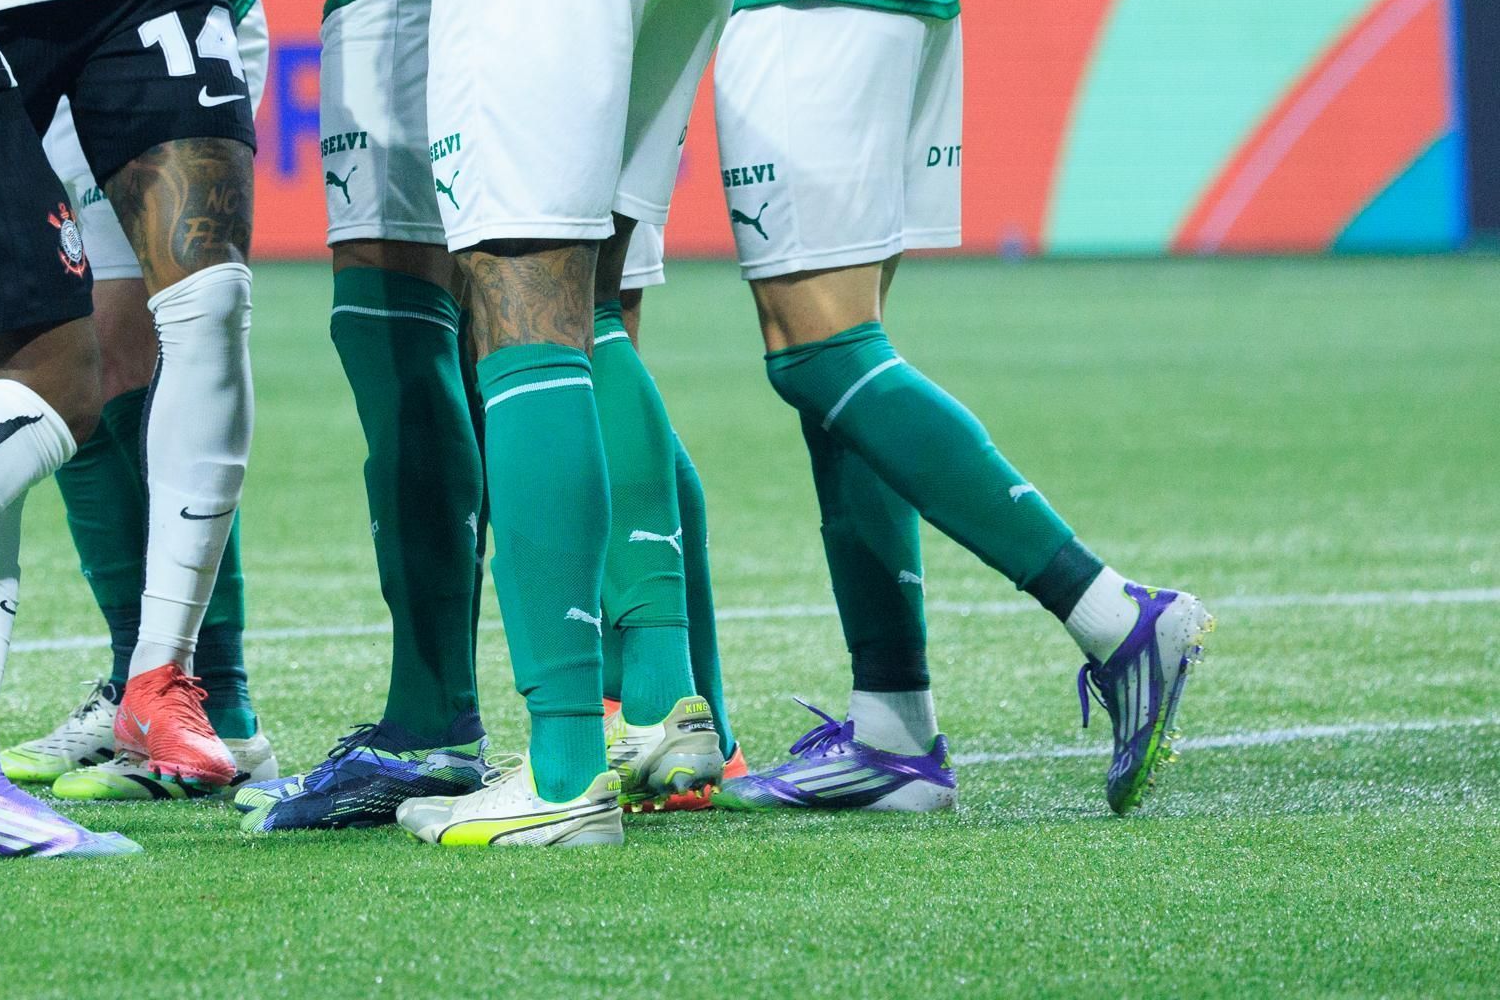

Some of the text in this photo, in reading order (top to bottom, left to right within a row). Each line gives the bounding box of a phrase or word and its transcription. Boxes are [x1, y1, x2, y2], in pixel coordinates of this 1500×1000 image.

[137, 5, 245, 82] 14
[926, 146, 962, 168] D'IT
[722, 163, 775, 187] SELVI
[685, 702, 708, 714] KING
[607, 780, 621, 791] KIN
